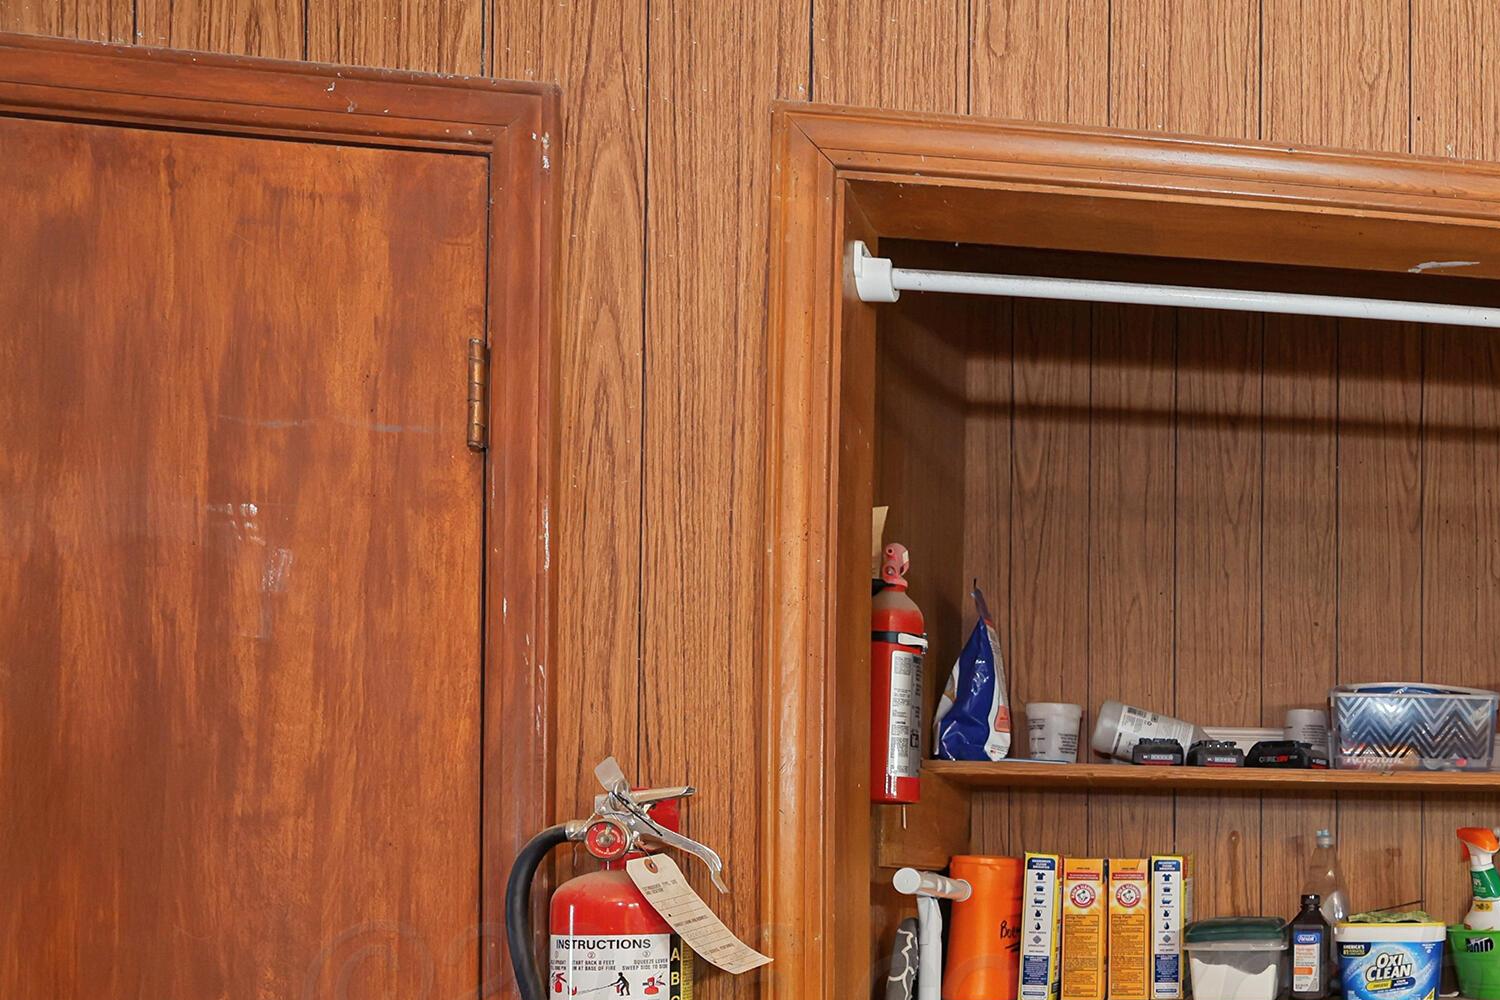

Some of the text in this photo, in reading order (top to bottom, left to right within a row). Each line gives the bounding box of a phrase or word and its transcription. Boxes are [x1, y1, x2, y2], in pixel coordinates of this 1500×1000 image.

[556, 939, 651, 950] INSTRUCTIONS
[670, 948, 680, 961] A
[1376, 953, 1404, 968] OXI
[670, 971, 680, 986] B
[1366, 963, 1412, 982] CLEAN
